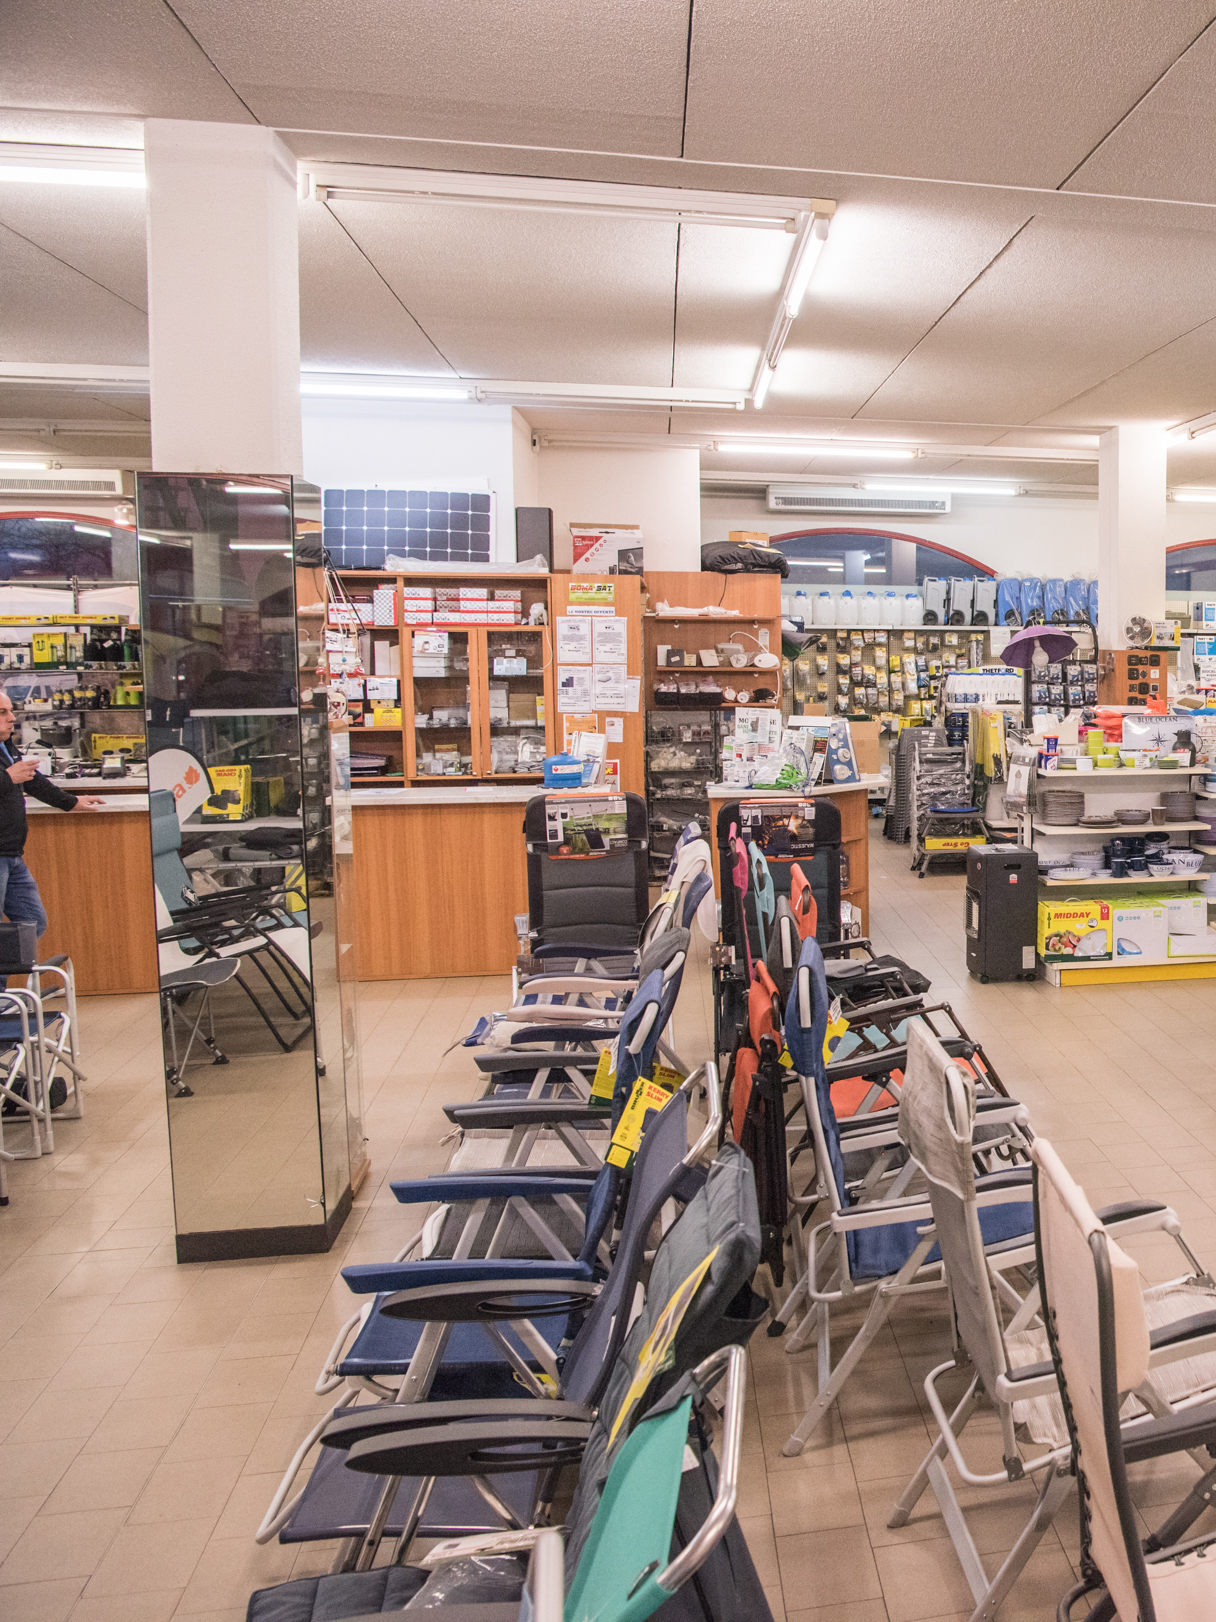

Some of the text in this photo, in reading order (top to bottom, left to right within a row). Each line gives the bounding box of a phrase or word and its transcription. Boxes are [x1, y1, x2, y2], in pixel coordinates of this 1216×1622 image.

[631, 1081, 645, 1111] BRUNNER
[645, 1091, 663, 1104] SLIM
[648, 1084, 670, 1100] KERRY
